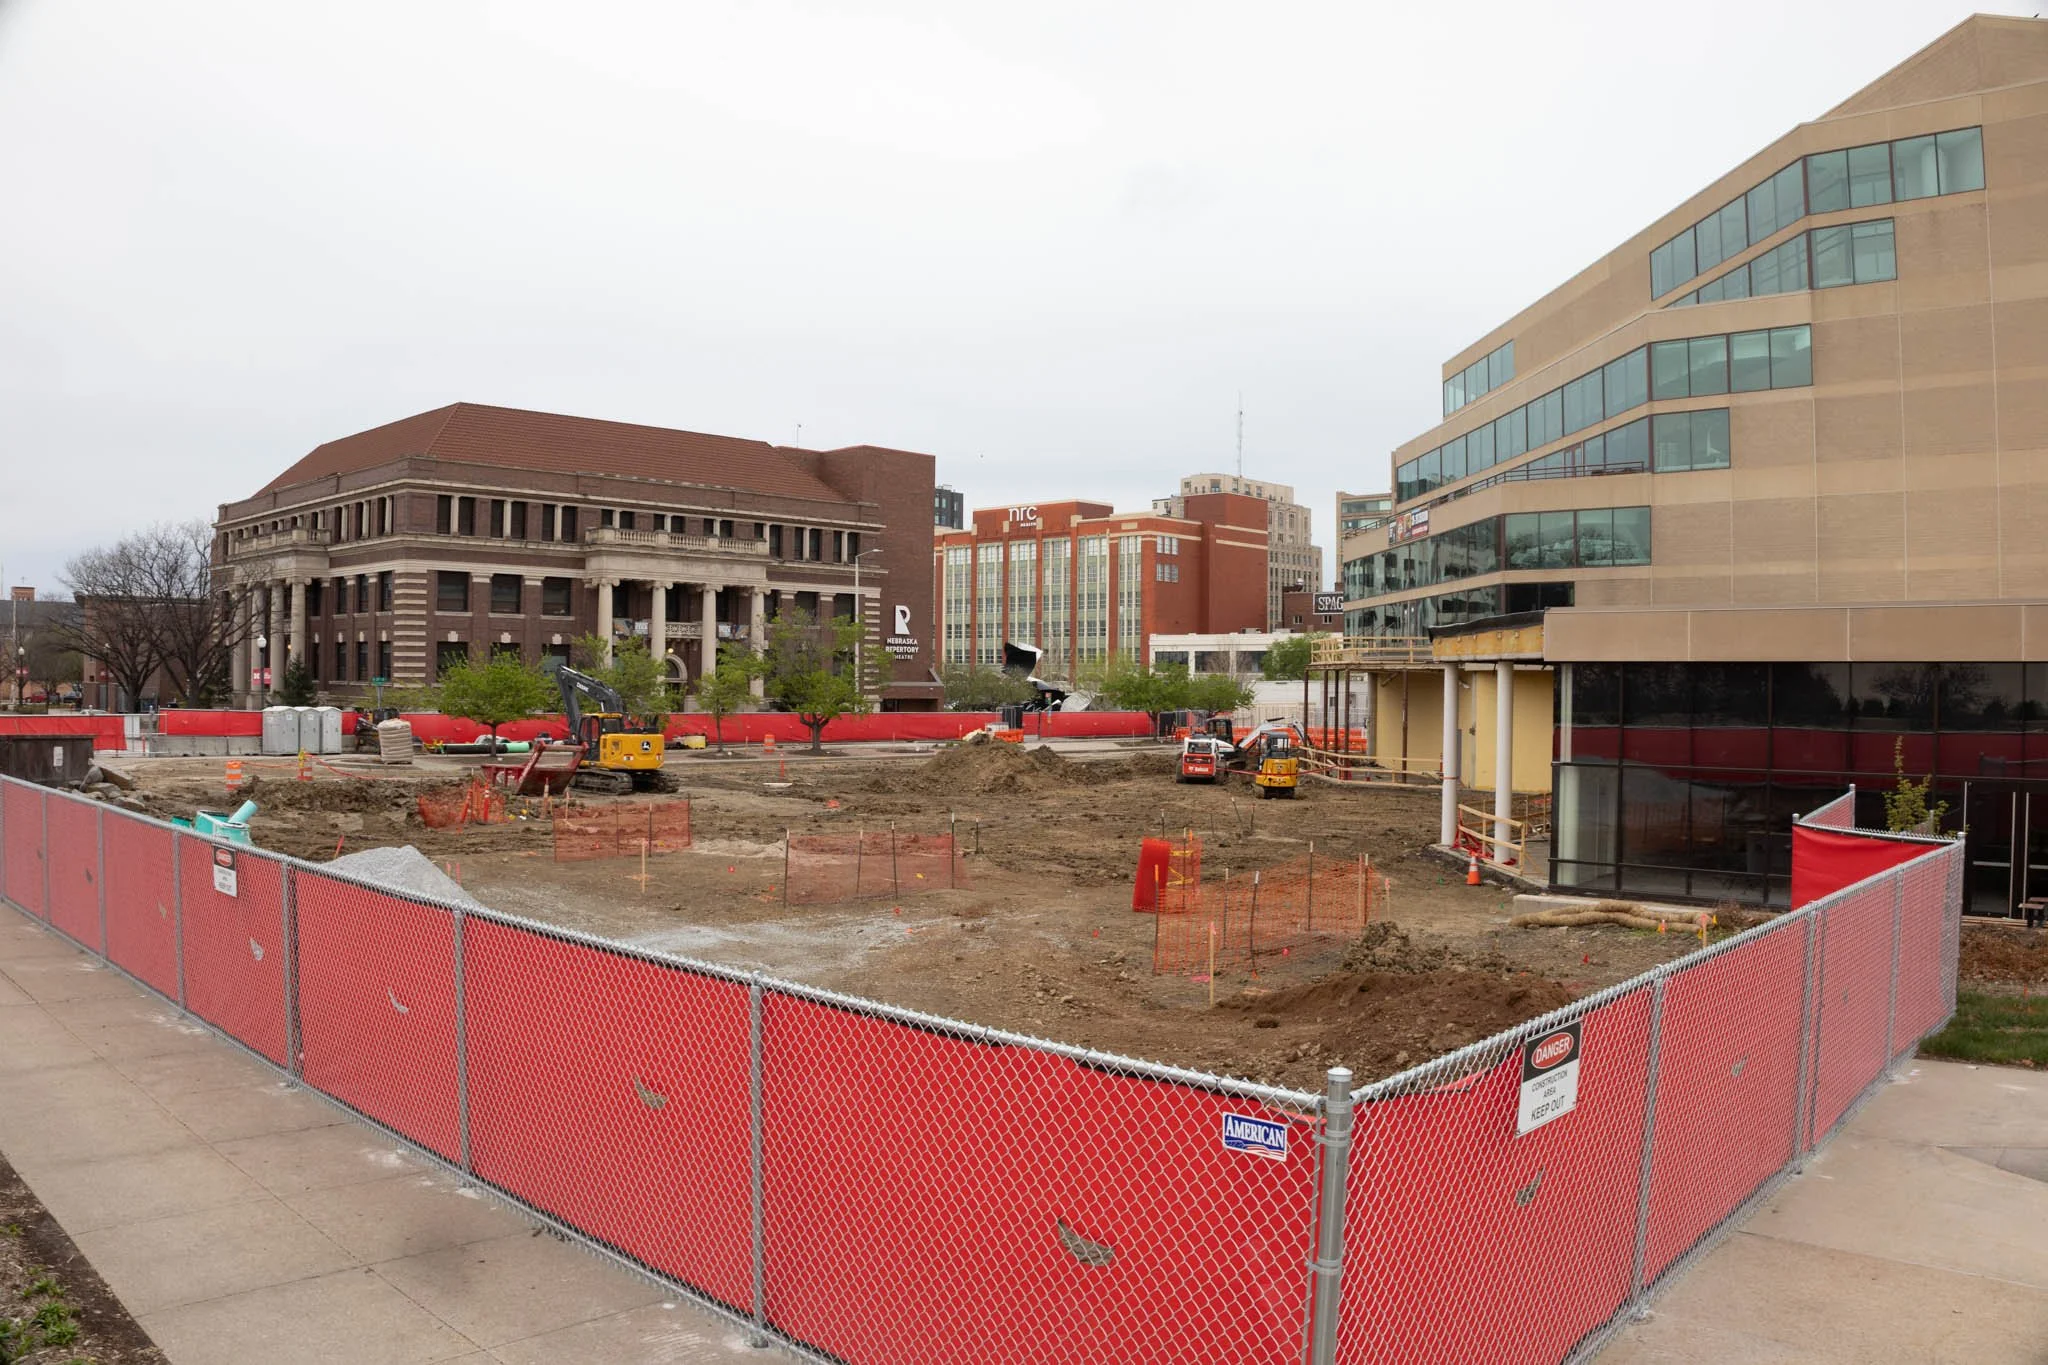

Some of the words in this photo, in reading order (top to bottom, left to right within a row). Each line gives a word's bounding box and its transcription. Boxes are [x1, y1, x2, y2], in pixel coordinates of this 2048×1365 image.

[1008, 506, 1037, 521] nrc
[1318, 596, 1344, 611] SPAG
[886, 637, 918, 645] NEBRASKA
[1535, 1037, 1570, 1063] DANGER
[1531, 1069, 1568, 1092] CONSTRUCTION
[1543, 1087, 1556, 1098] AREA
[1531, 1102, 1549, 1121] KEEP
[1550, 1095, 1565, 1112] OUT
[1225, 1115, 1285, 1149] AMERICAN
